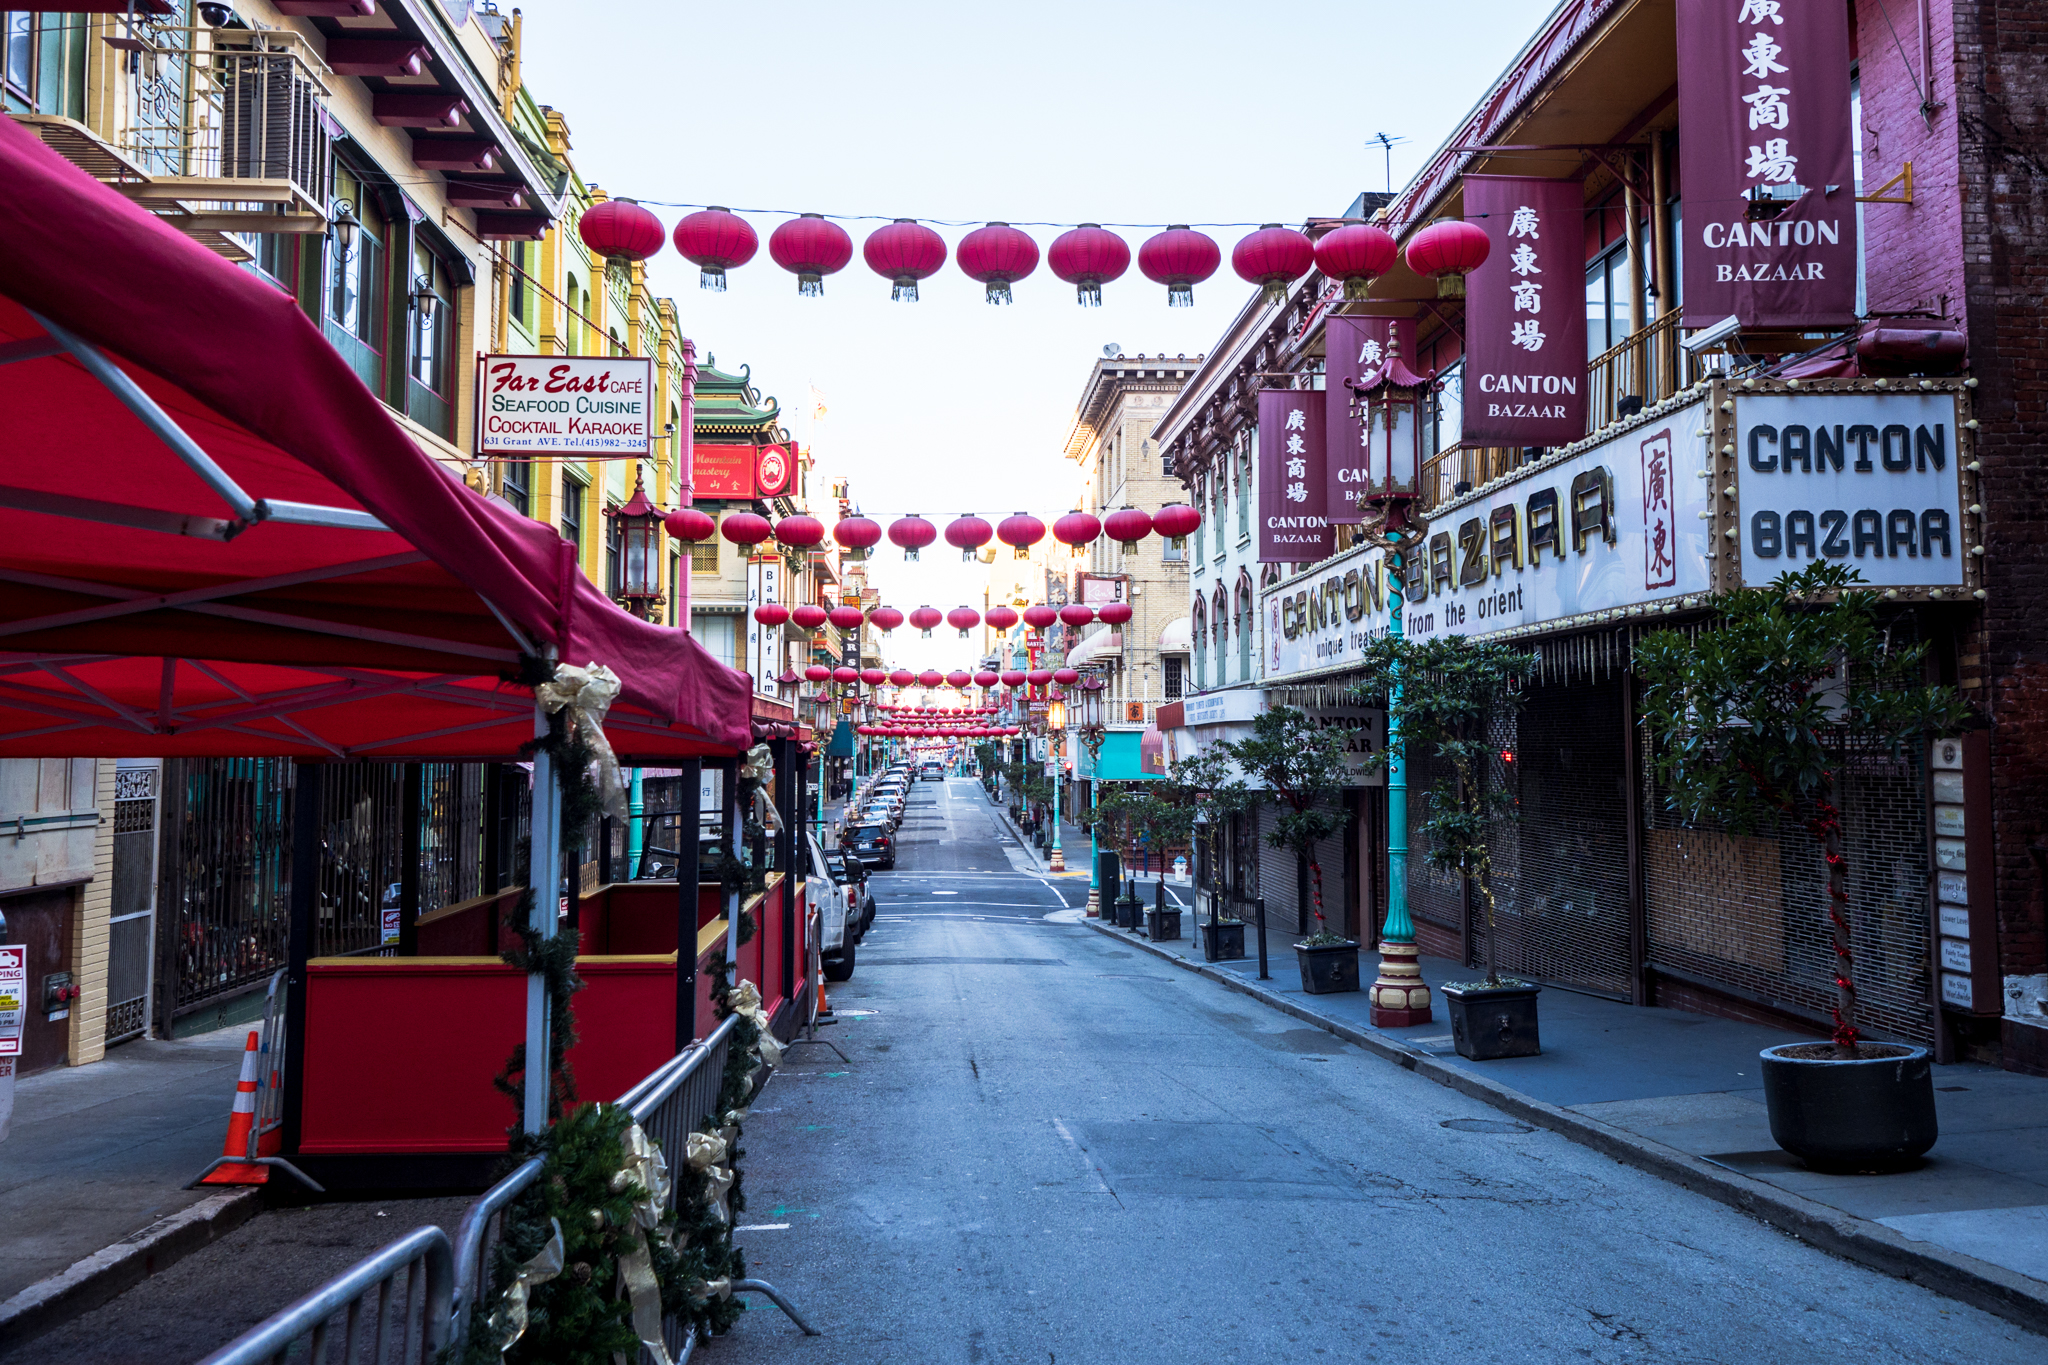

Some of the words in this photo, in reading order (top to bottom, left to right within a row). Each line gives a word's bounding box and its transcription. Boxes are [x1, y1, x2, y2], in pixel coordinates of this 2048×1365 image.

[1702, 219, 1840, 249] CANTON
[1507, 205, 1547, 352] 廣東商場
[1715, 262, 1826, 282] BAZAAR
[490, 362, 540, 393] Far
[544, 364, 611, 394] East
[610, 378, 643, 394] CAFÉ
[1479, 373, 1577, 395] CANTON
[1487, 403, 1567, 419] BAZAAR
[484, 437, 499, 445] 631
[503, 437, 532, 446] Grant
[537, 438, 561, 446] AVE.
[1748, 423, 1946, 472] CANTON
[693, 453, 742, 464] Mountain
[1285, 408, 1309, 503] 廣東商場
[693, 467, 731, 478] nastery
[1337, 468, 1369, 483] CAN
[1647, 448, 1672, 578] 廣東
[1267, 515, 1328, 529] CANTON
[1272, 534, 1322, 543] BAZAAR
[1751, 507, 1951, 558] BAZAAR
[1282, 558, 1384, 642] CANTON
[1403, 465, 1617, 603] BAZAAR
[1316, 637, 1343, 659] unique
[1407, 611, 1434, 636] from
[1445, 600, 1466, 628] the
[1478, 583, 1523, 620] orient
[1308, 716, 1373, 731] ANTON
[702, 787, 711, 797] 行
[1940, 880, 1955, 891] Upper
[1955, 883, 1966, 892] Leve
[1942, 914, 1956, 924] Lower
[1949, 958, 1966, 967] Products
[1948, 979, 1956, 987] We
[1956, 981, 1968, 991] Ship
[1946, 989, 1971, 1002] Worldwide
